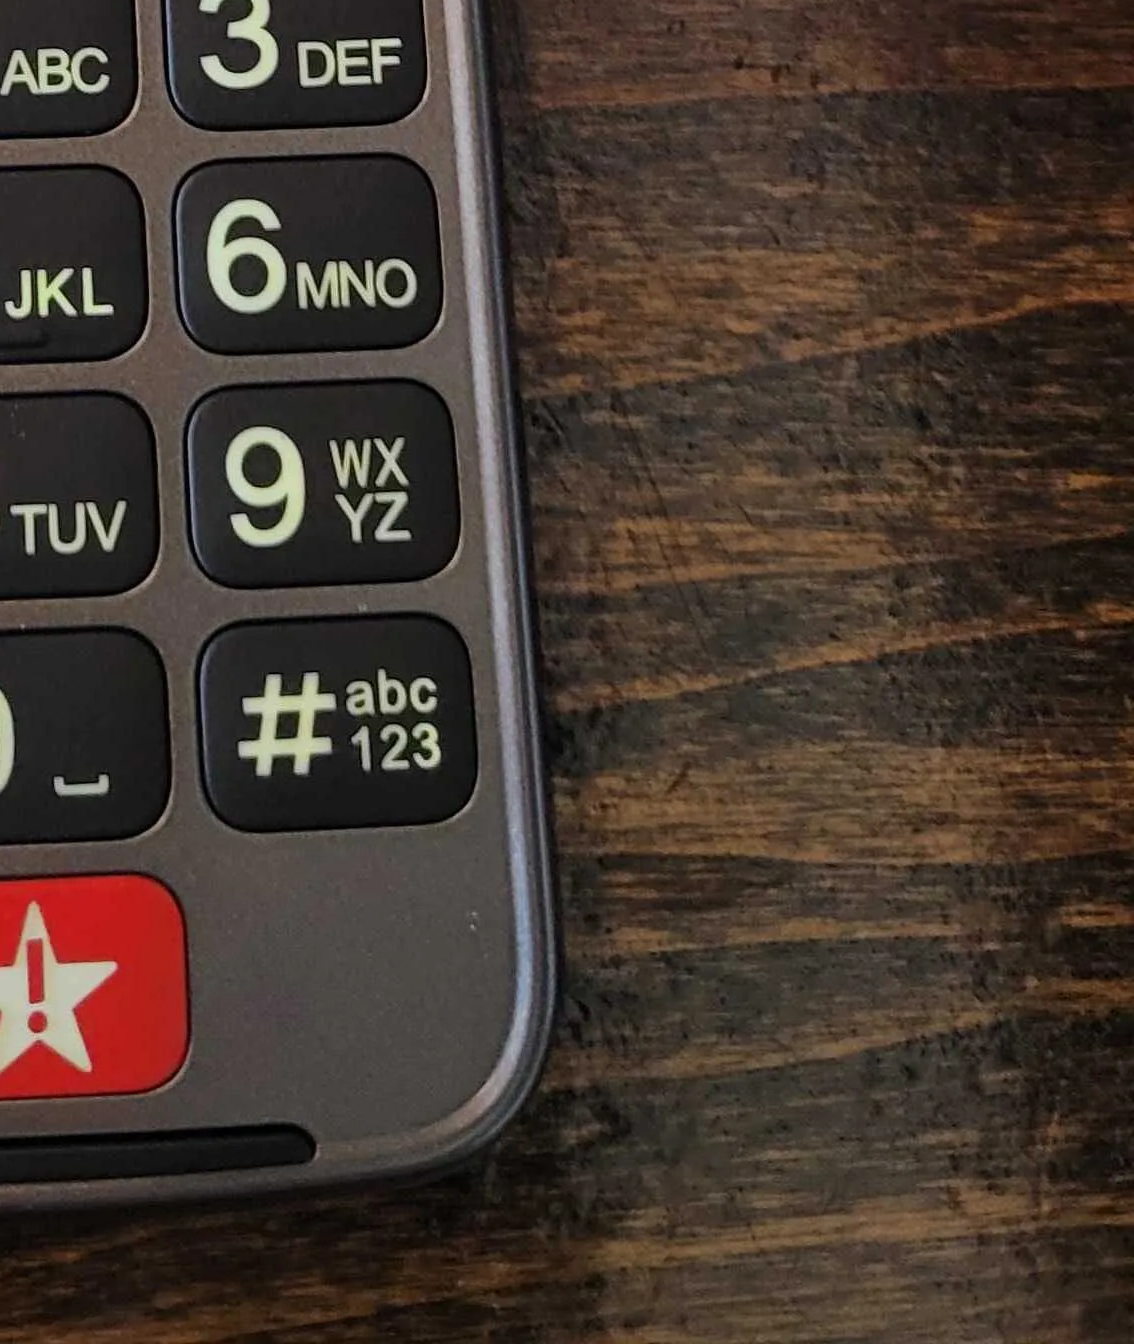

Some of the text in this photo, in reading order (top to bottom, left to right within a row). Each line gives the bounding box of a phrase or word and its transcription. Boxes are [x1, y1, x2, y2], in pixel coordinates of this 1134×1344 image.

[0, 48, 109, 95] ABC
[298, 38, 401, 87] DEF
[207, 200, 417, 312] 6 MNO
[5, 268, 114, 318] JKL
[226, 427, 305, 546] 9
[330, 438, 408, 490] WX
[10, 501, 126, 554] TUV
[335, 492, 411, 542] YZ
[346, 669, 437, 715] abc
[239, 672, 336, 776] #
[352, 723, 441, 770] 123
